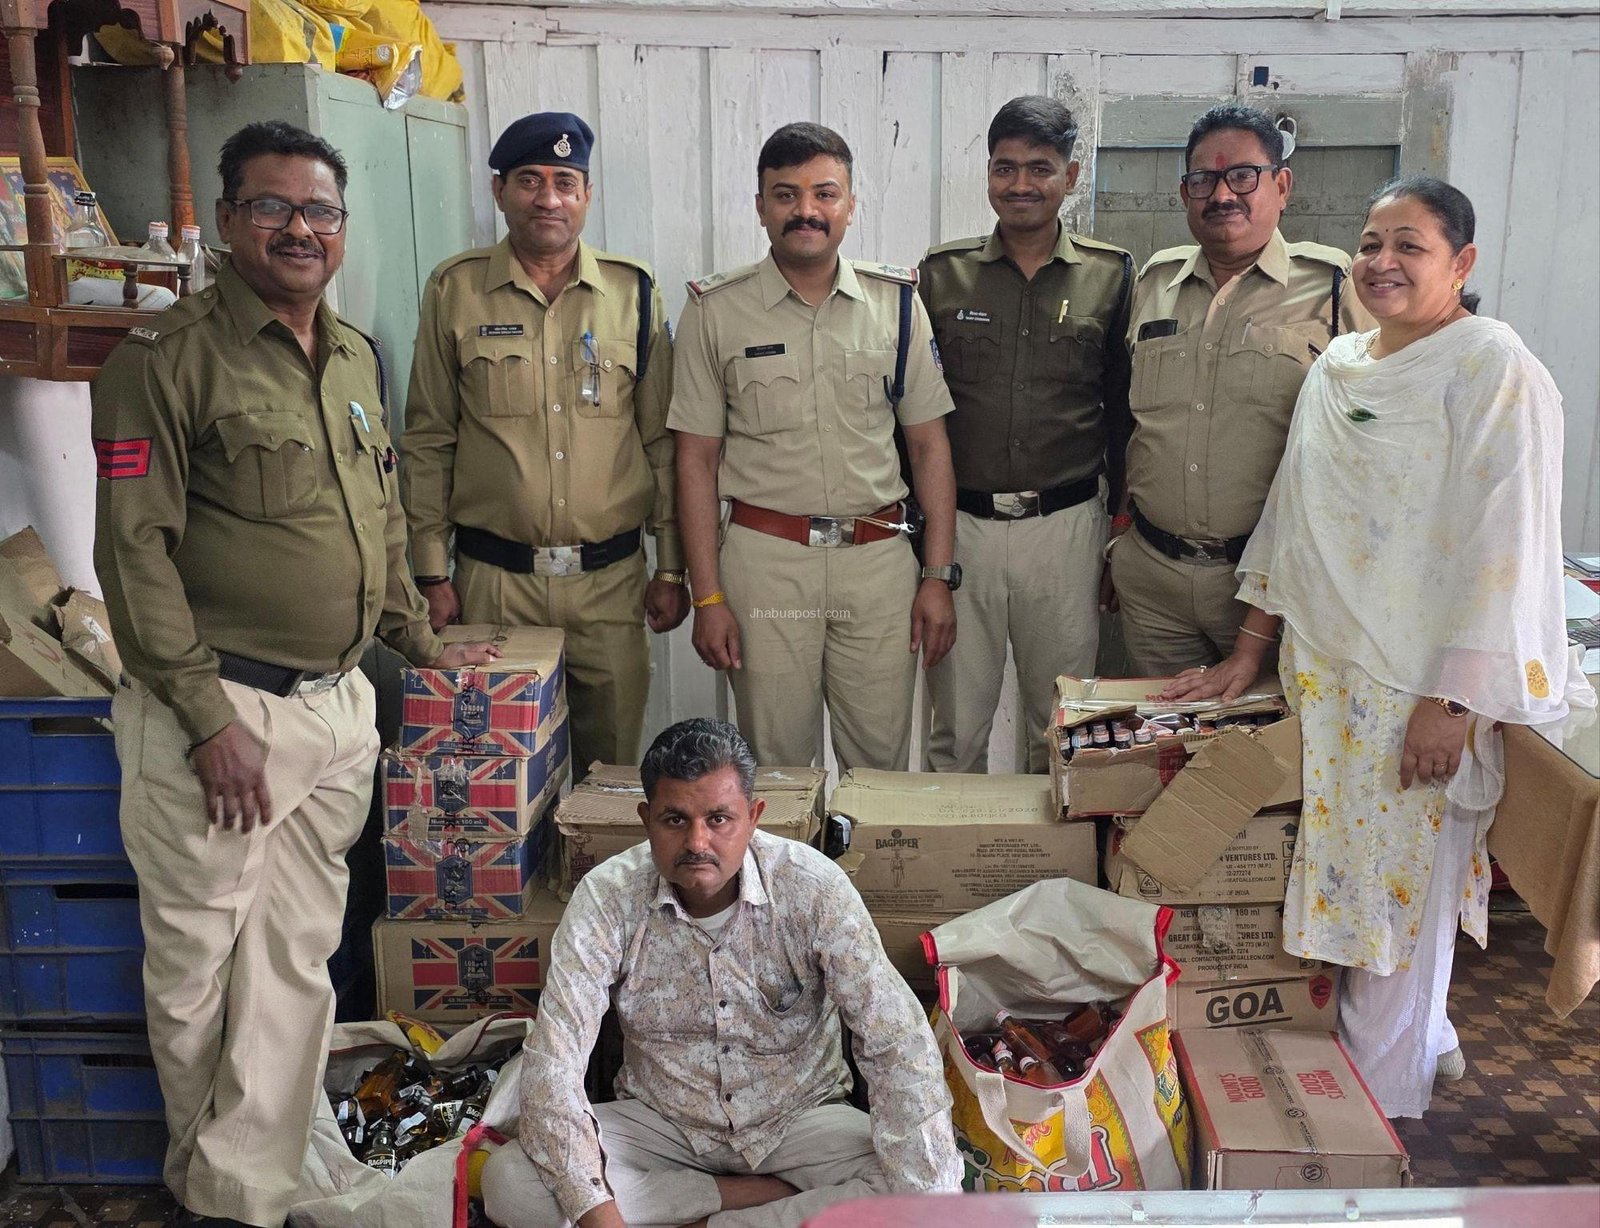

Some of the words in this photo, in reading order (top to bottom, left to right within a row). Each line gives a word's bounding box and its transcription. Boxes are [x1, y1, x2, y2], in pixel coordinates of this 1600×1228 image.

[875, 838, 919, 850] BAGPIPER
[1225, 853, 1262, 862] VENTURES
[1263, 853, 1278, 861] LTD.
[1180, 910, 1198, 918] NEW
[1250, 908, 1260, 916] ml
[1168, 934, 1191, 943] GREAT
[1261, 931, 1276, 939] LTD.
[1205, 987, 1284, 1024] GOA
[1238, 1076, 1266, 1099] 6000
[1296, 1072, 1326, 1096] 6000
